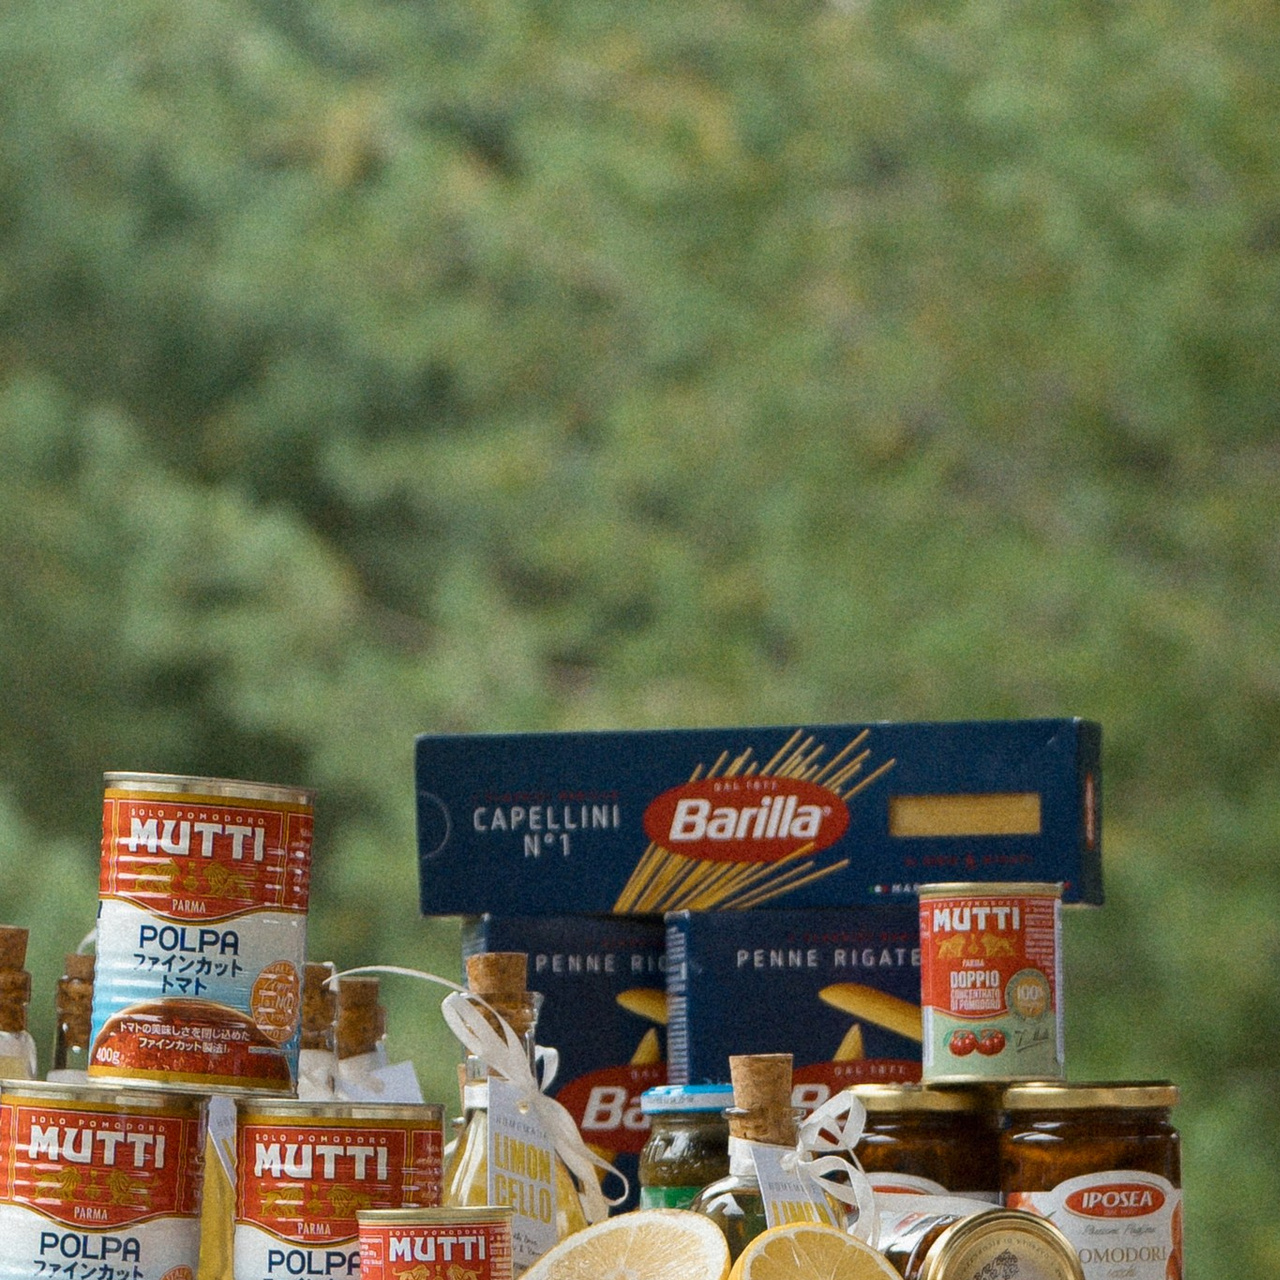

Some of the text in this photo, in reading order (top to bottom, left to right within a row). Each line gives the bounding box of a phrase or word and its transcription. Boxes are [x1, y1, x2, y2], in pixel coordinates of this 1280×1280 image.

[131, 808, 266, 825] SOLO POMODORO
[473, 804, 621, 832] CAPELLINI
[128, 817, 265, 862] MUTTI
[523, 832, 571, 858] N°1
[172, 899, 206, 913] PARMA
[933, 907, 1020, 933] MUTTI
[139, 924, 240, 956] POLPA
[133, 953, 243, 978] ファインカット
[535, 955, 616, 973] PENNE
[736, 948, 921, 968] PENNE RIGATE
[162, 975, 207, 996] トマト
[950, 970, 1000, 989] DOPPIO
[120, 1021, 250, 1042] トマトの美味しさを閉じ込めた
[95, 1047, 121, 1065] 400g
[31, 1115, 165, 1133] SOLO POMODORO
[28, 1125, 165, 1169] MUTTI
[255, 1133, 387, 1144] SOLO POMODORO
[254, 1142, 389, 1181] MUTTI
[494, 1132, 551, 1185] LIMON
[494, 1172, 552, 1225] CELLO
[1082, 1190, 1153, 1209] IPOSEA
[74, 1206, 108, 1220] PARMA
[297, 1222, 332, 1236] PARMA
[389, 1229, 485, 1237] SOLO POMODORO
[39, 1231, 142, 1263] POLPA
[389, 1235, 487, 1262] MUTTI
[1078, 1246, 1167, 1264] OMODORI
